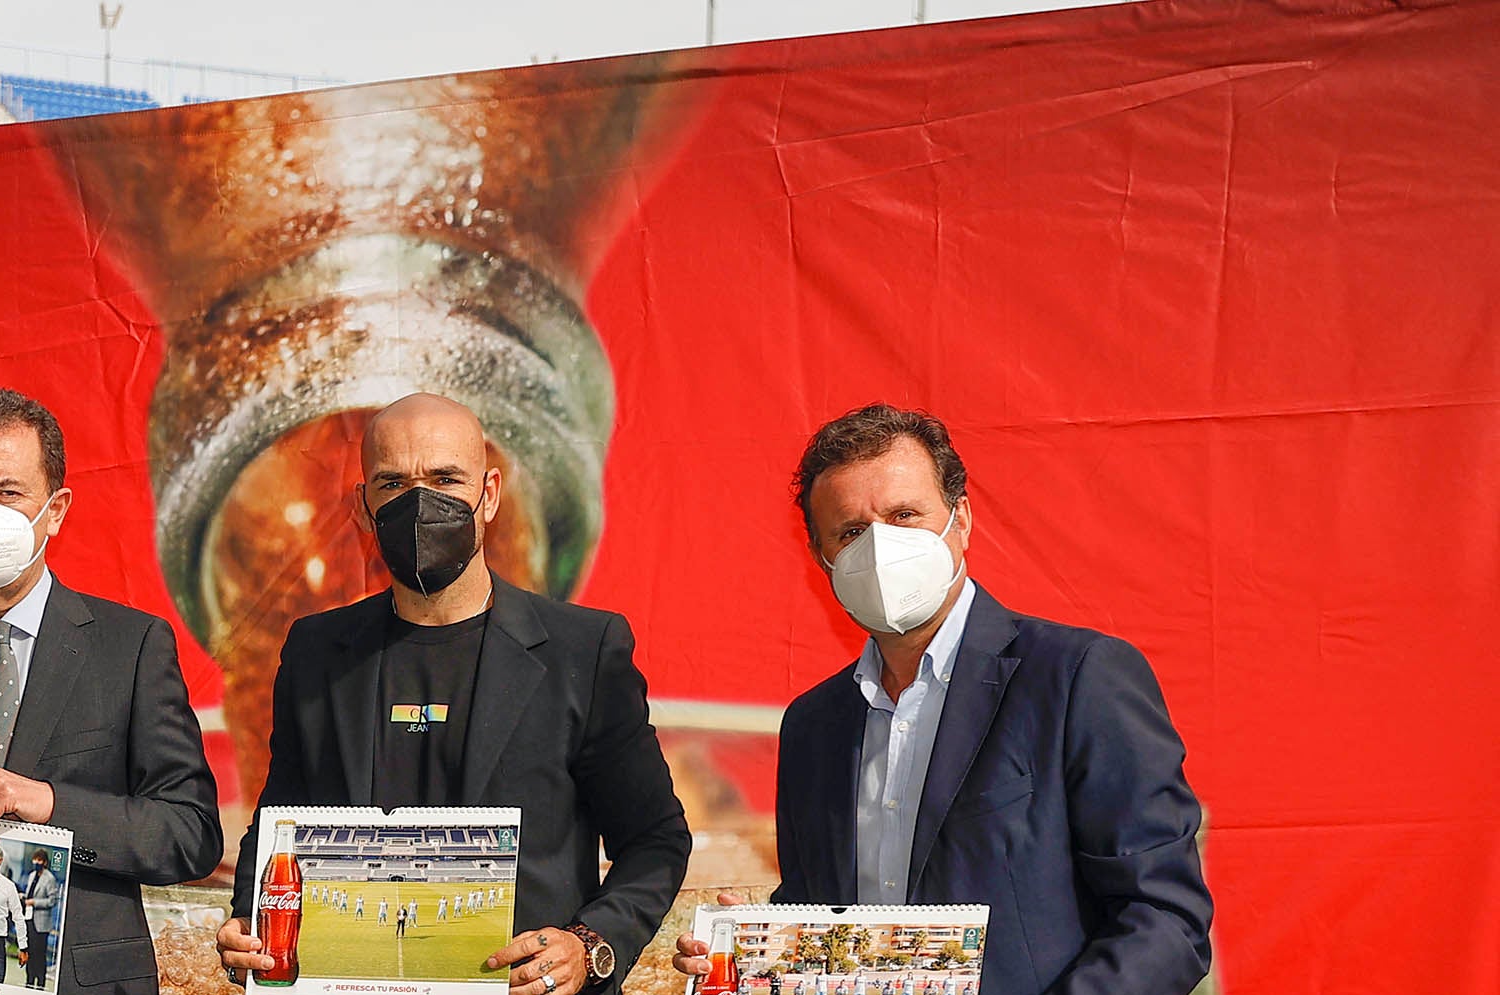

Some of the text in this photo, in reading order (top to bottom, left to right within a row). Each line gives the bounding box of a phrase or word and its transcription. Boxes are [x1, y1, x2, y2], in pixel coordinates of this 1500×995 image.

[259, 891, 301, 910] Coca-Cola
[335, 984, 418, 993] REFRESCA TU PASIÓN
